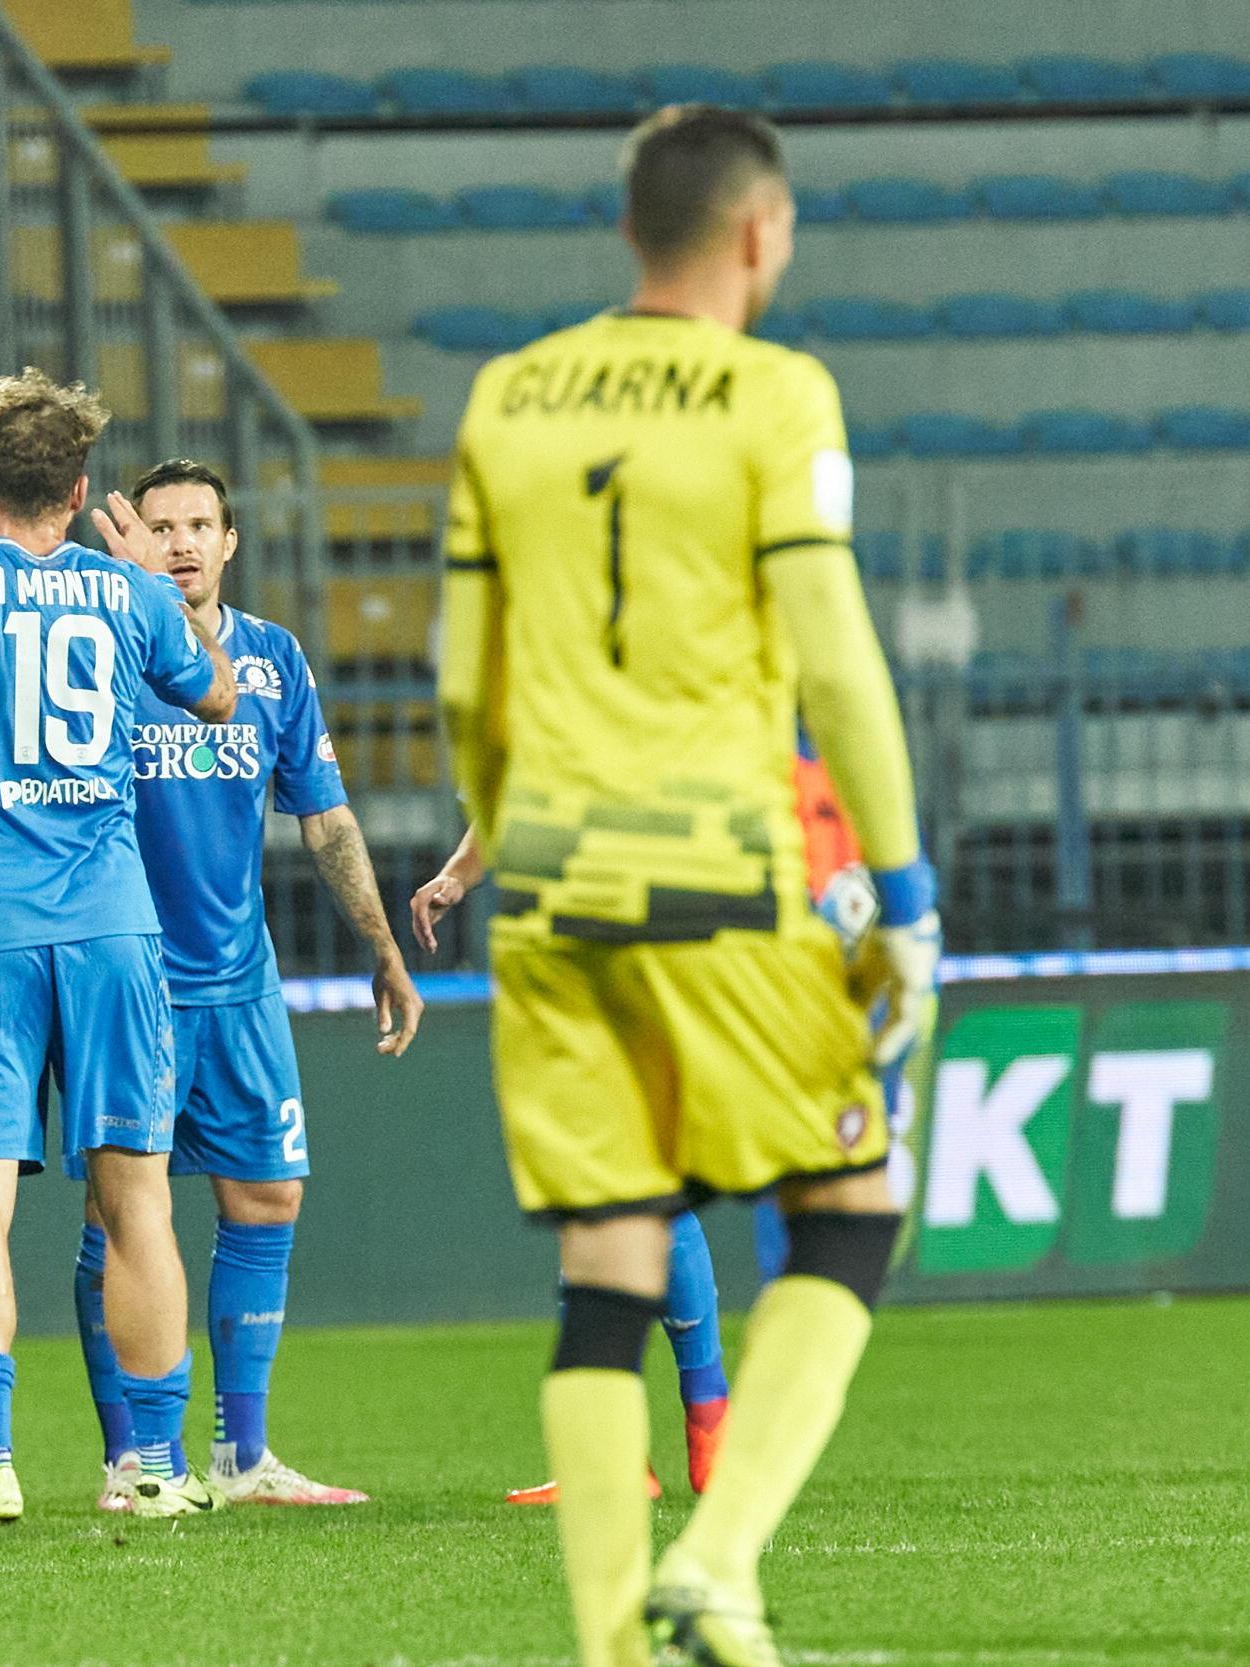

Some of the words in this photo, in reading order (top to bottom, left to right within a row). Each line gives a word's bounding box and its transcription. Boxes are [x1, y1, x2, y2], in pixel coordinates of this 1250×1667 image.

[502, 358, 734, 418] GUARNA
[16, 568, 130, 614] MANTIA
[584, 450, 630, 671] 1
[3, 611, 116, 767] 19
[130, 724, 259, 744] COMPUTER
[132, 742, 260, 780] GROSS
[280, 1097, 307, 1163] 2
[888, 1046, 1215, 1228] KT
